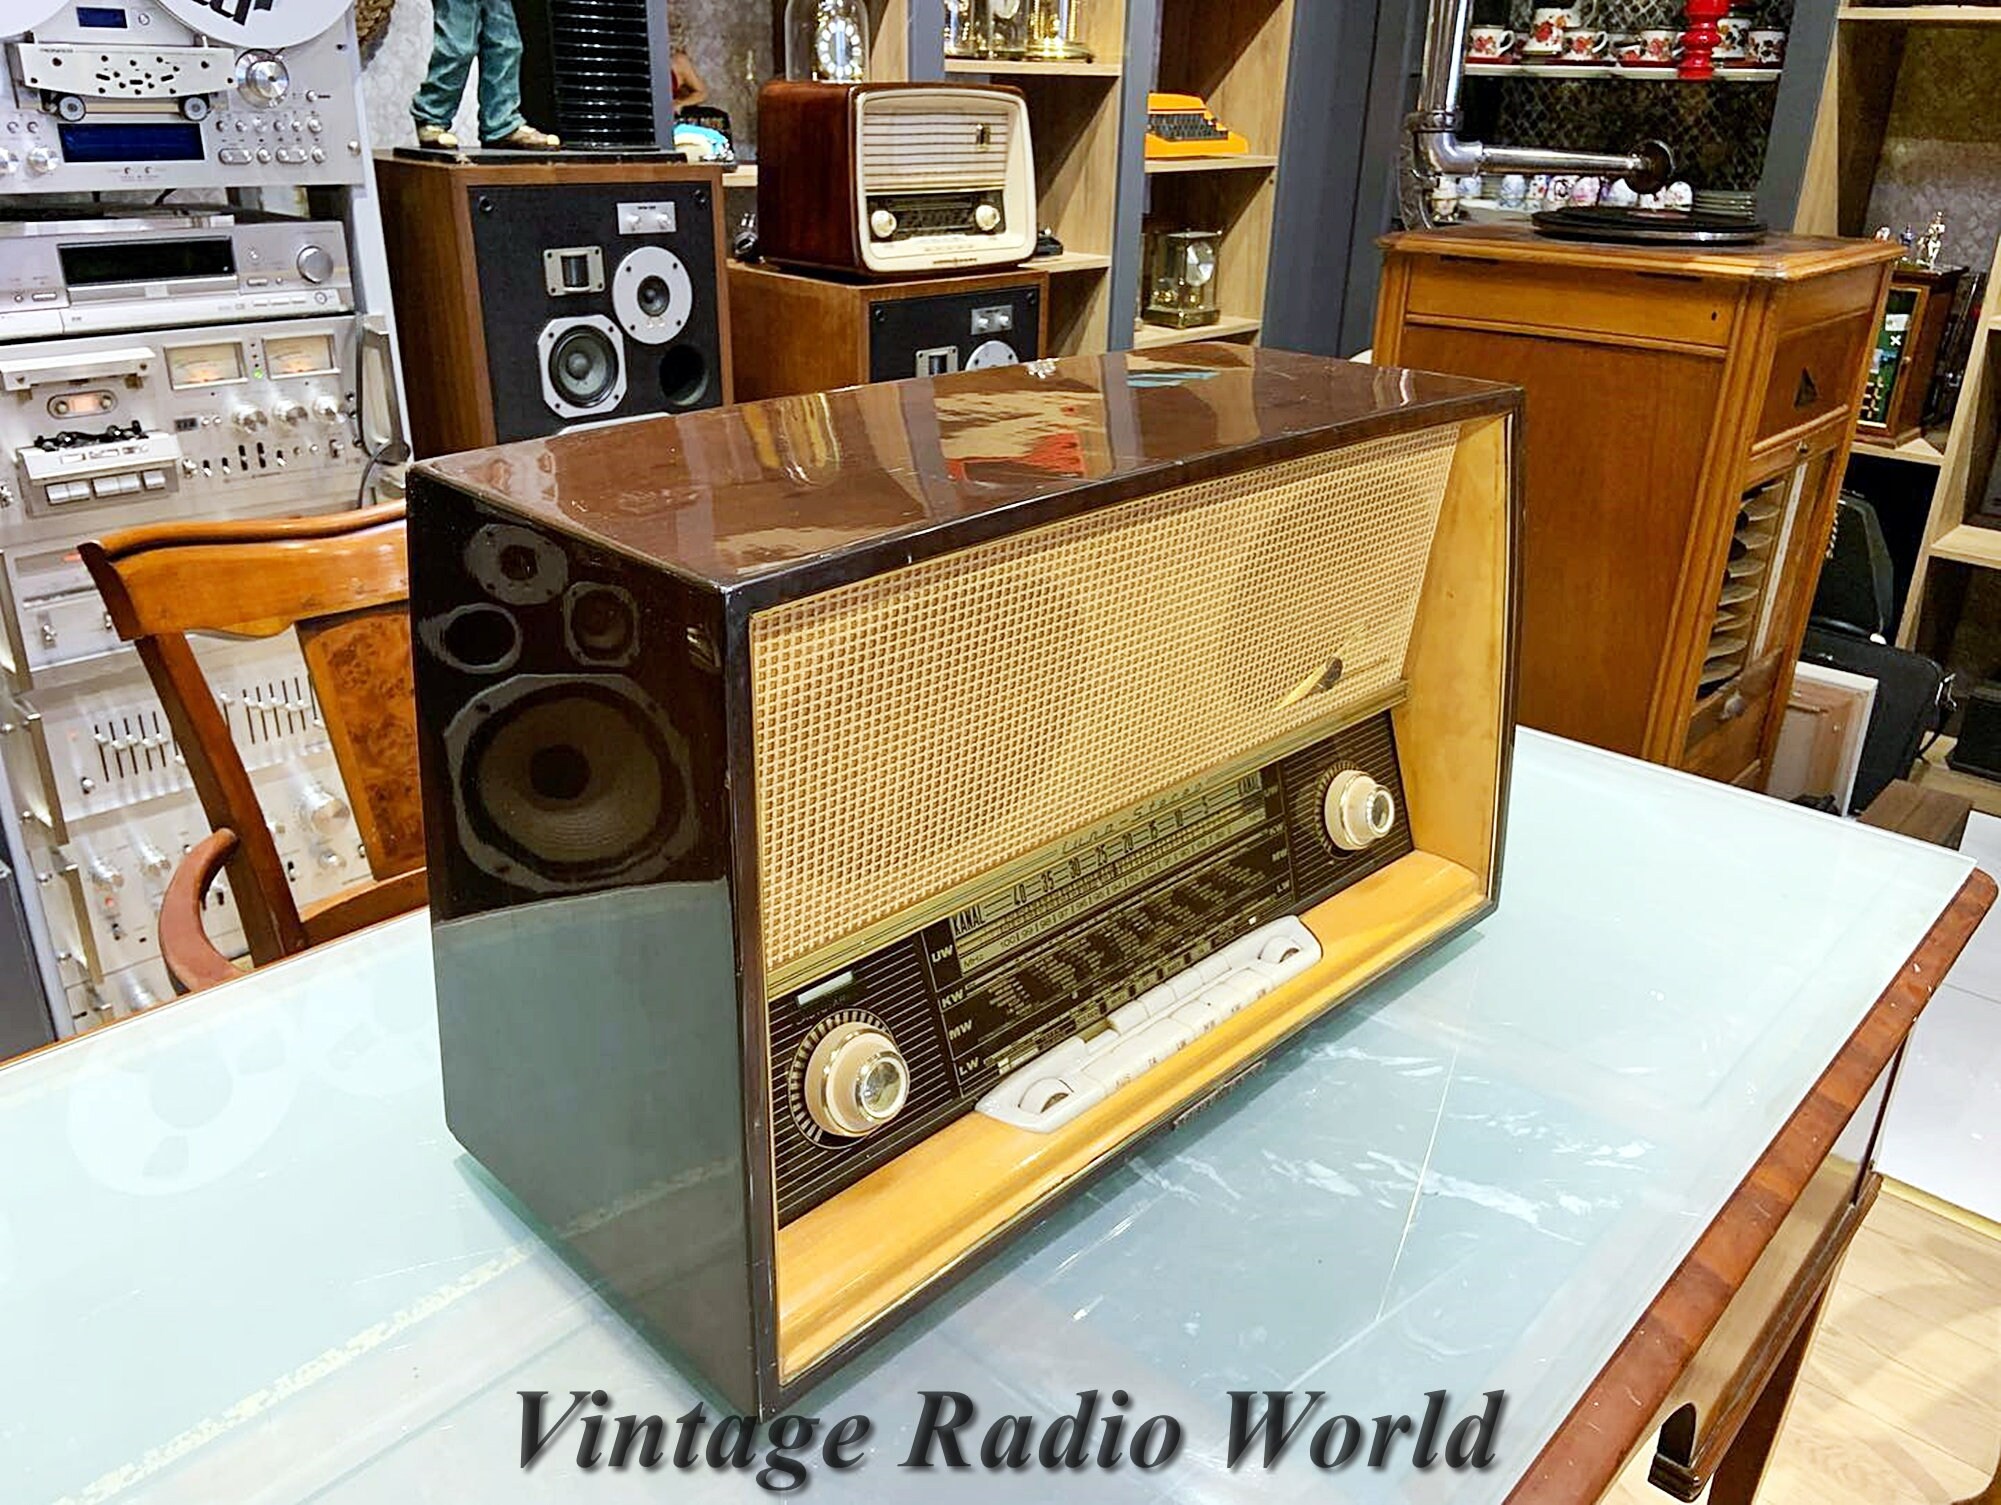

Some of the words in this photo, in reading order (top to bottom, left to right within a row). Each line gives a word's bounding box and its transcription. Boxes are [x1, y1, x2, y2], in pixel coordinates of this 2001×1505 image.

[954, 904, 986, 936] KANAL
[1014, 883, 1027, 905] 40
[1041, 871, 1055, 892] 35
[1068, 856, 1081, 878] 30
[1095, 844, 1108, 866] 25
[1122, 832, 1134, 853] 20
[931, 944, 953, 963] UW
[941, 988, 964, 1009] KW
[948, 1019, 973, 1041] MW
[959, 1056, 979, 1077] LW
